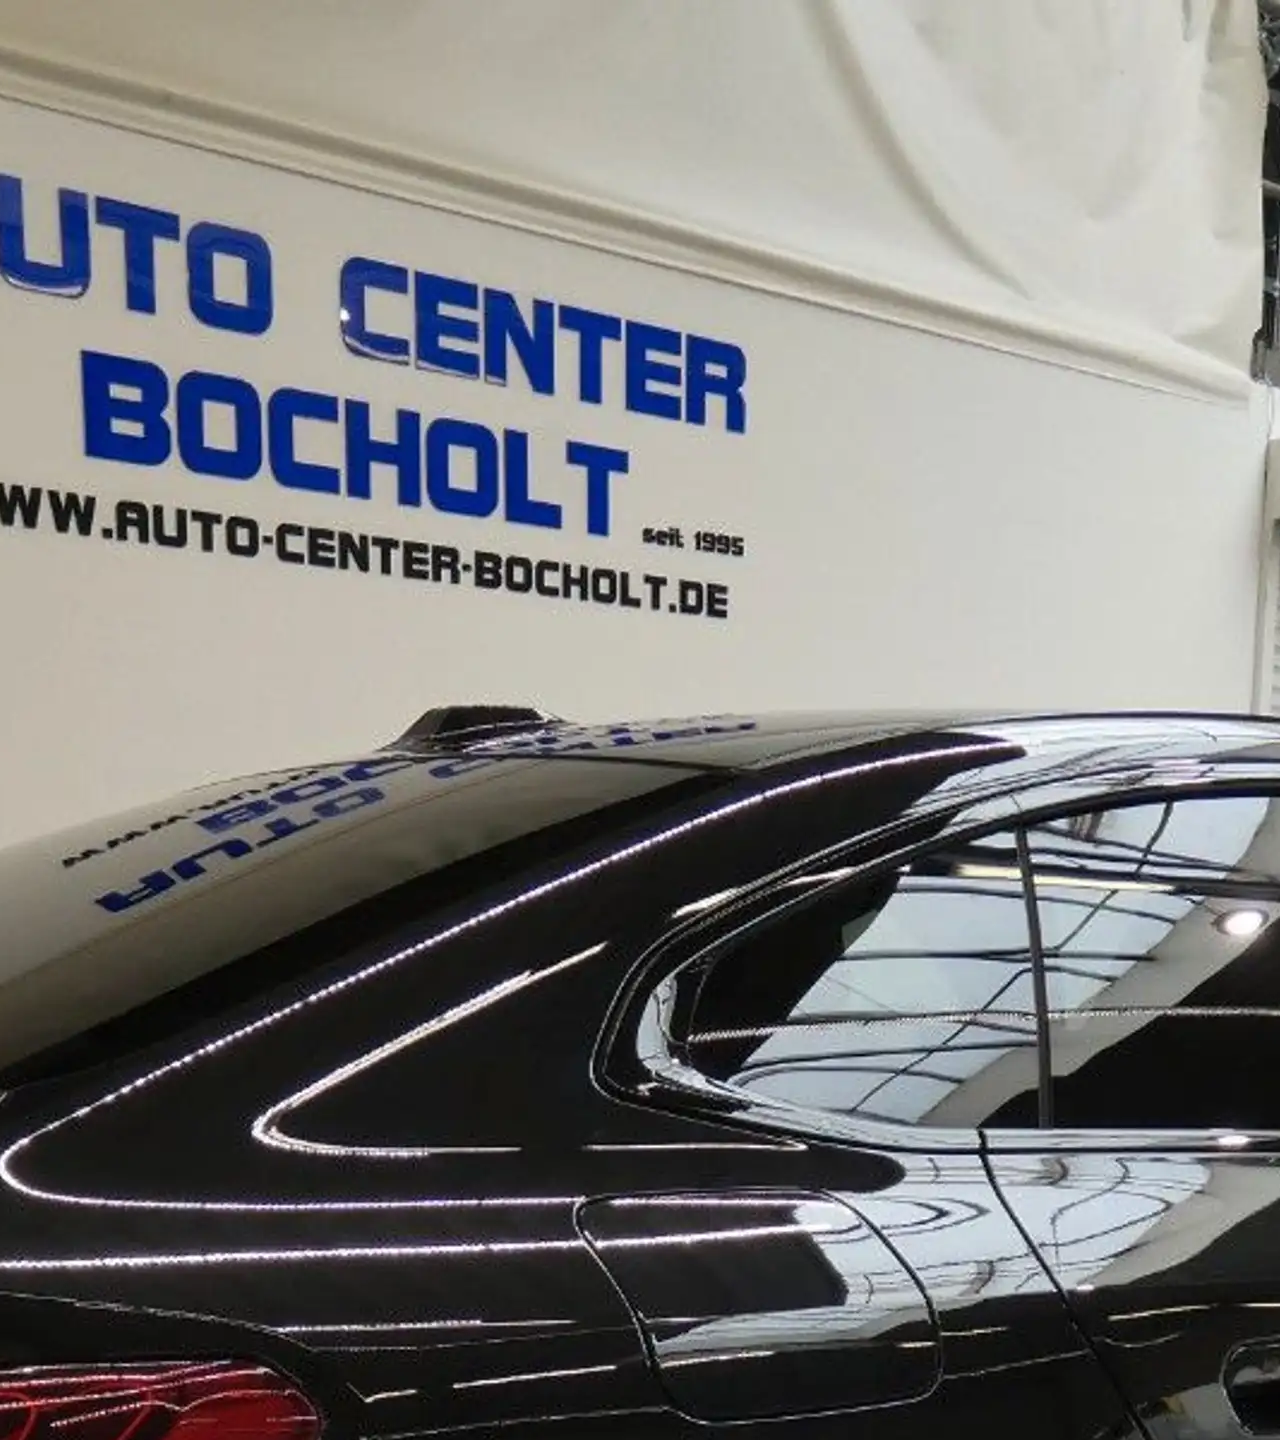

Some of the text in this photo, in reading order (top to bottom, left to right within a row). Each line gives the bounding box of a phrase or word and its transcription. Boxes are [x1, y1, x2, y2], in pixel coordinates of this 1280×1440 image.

[340, 257, 747, 434] CENTER
[81, 351, 631, 537] BOCHOLT
[642, 526, 745, 557] seit 1995
